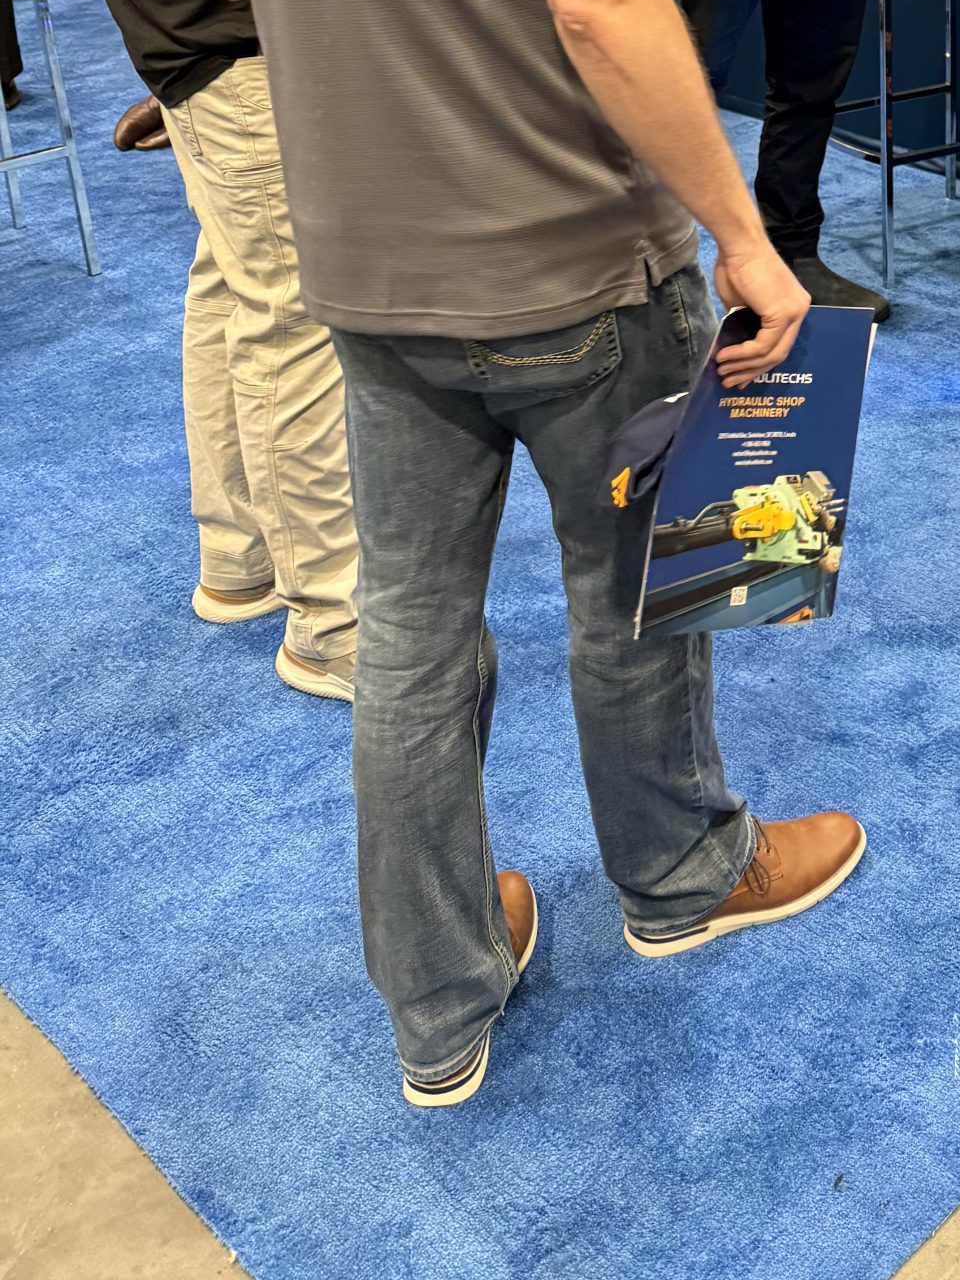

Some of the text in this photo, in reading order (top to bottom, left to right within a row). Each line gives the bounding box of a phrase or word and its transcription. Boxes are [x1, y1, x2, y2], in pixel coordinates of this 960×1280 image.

[719, 396, 806, 407] HYDRAULIC SHOP
[730, 408, 790, 418] MACHINERY
